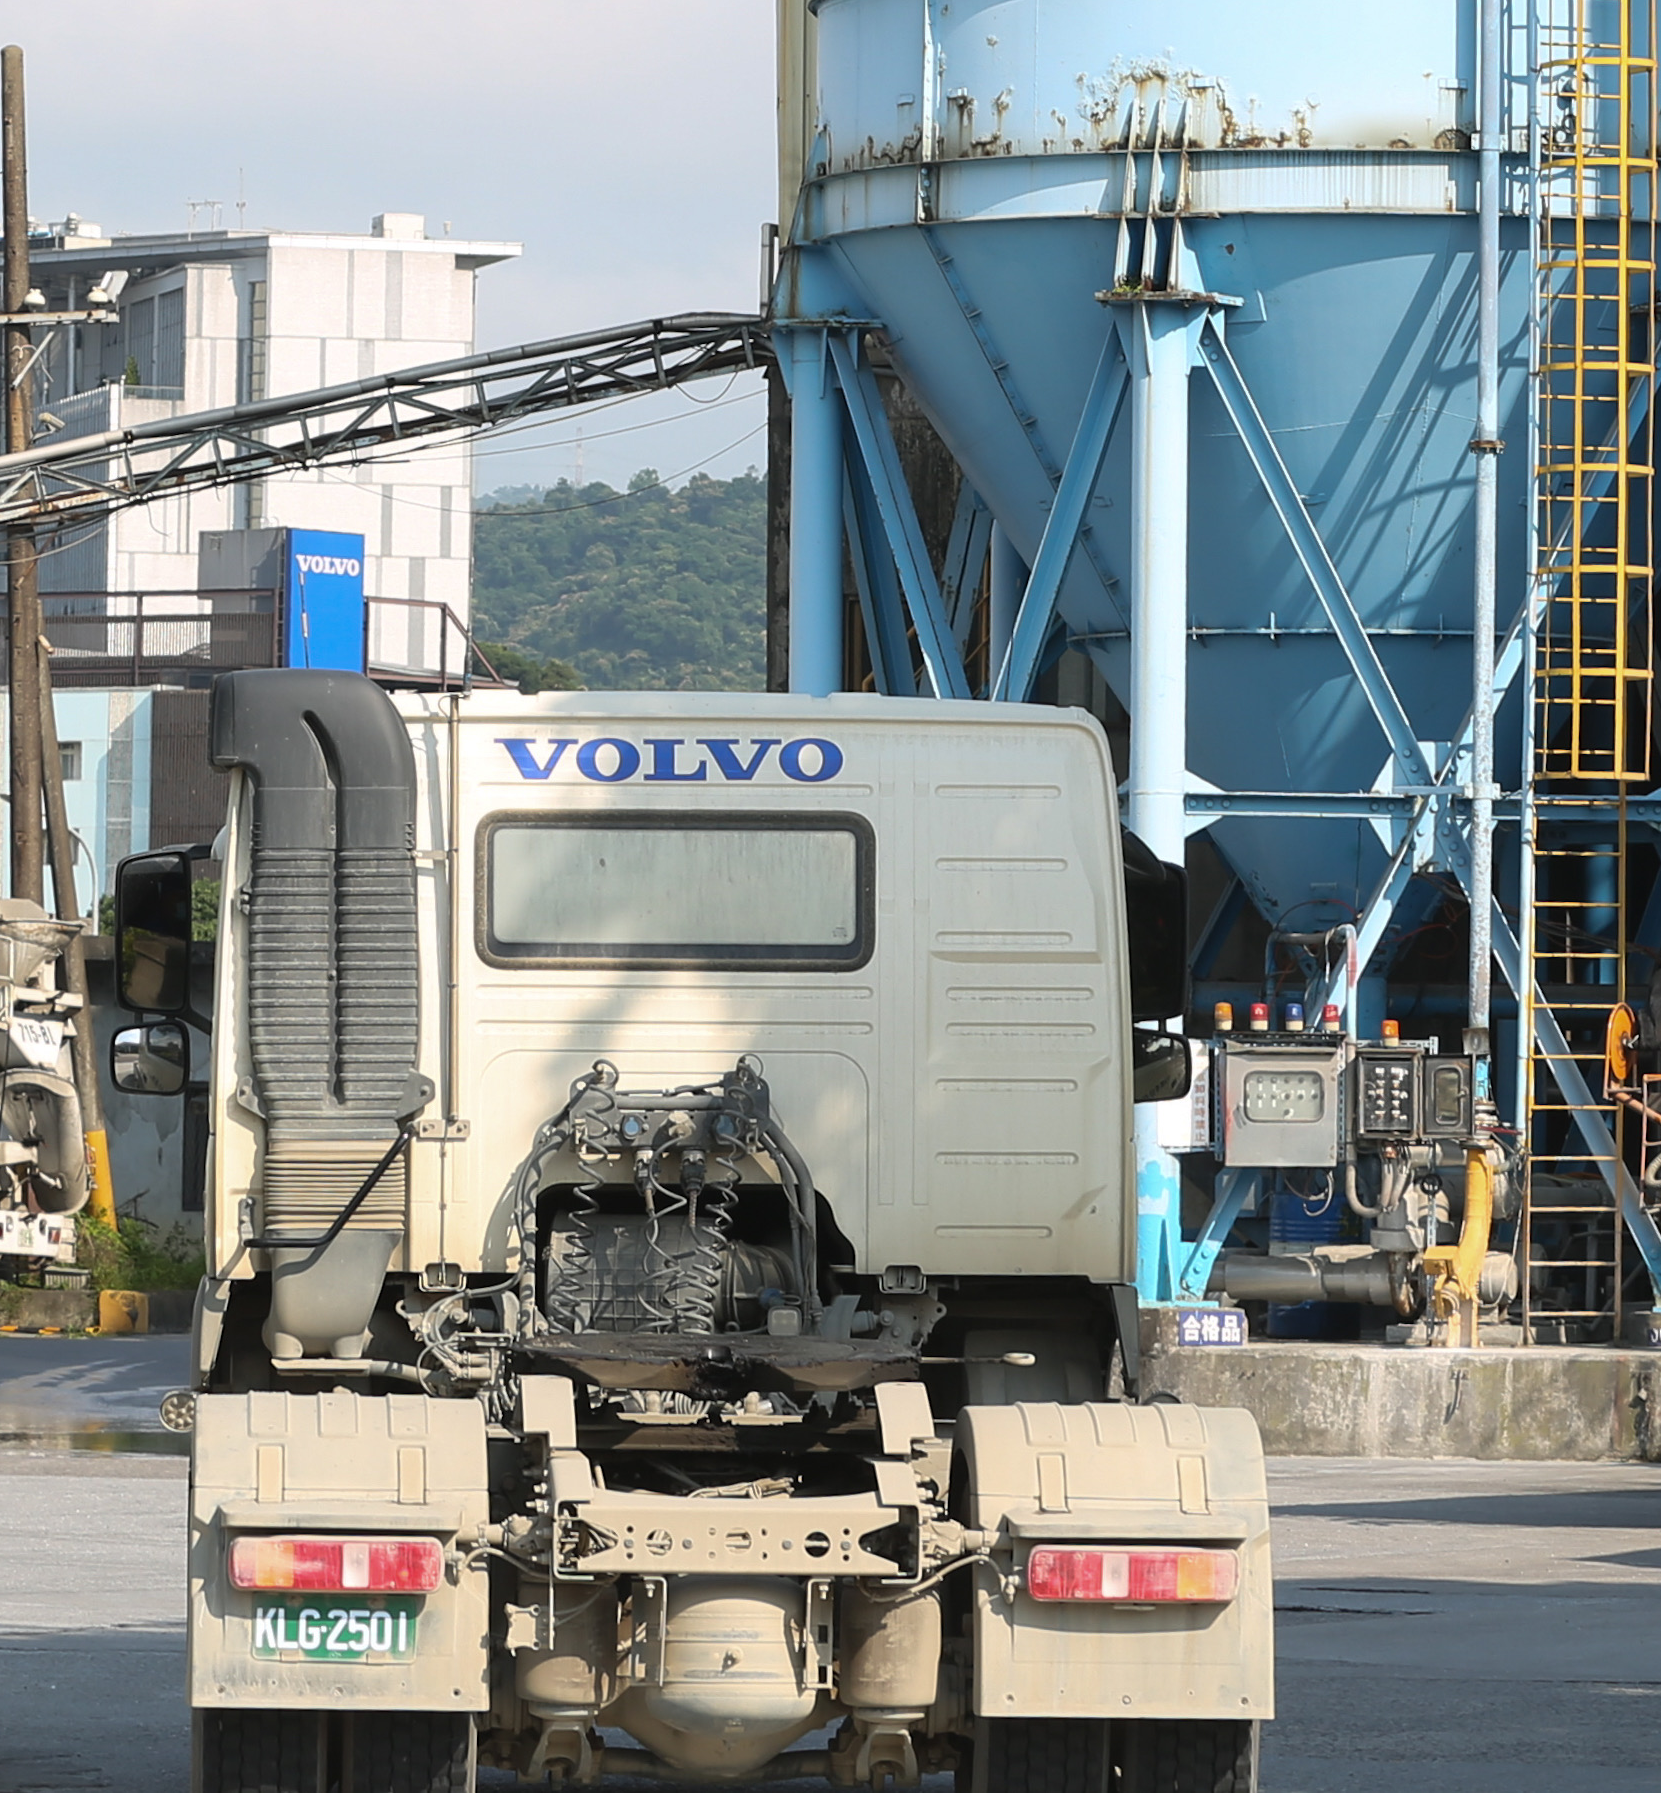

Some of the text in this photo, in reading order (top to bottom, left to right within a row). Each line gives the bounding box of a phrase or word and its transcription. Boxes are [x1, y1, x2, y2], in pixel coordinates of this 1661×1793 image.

[295, 554, 360, 577] VOLVO
[493, 737, 844, 783] VOLVO
[1182, 1314, 1241, 1342] 合格品
[255, 1607, 407, 1653] KLG-2501
